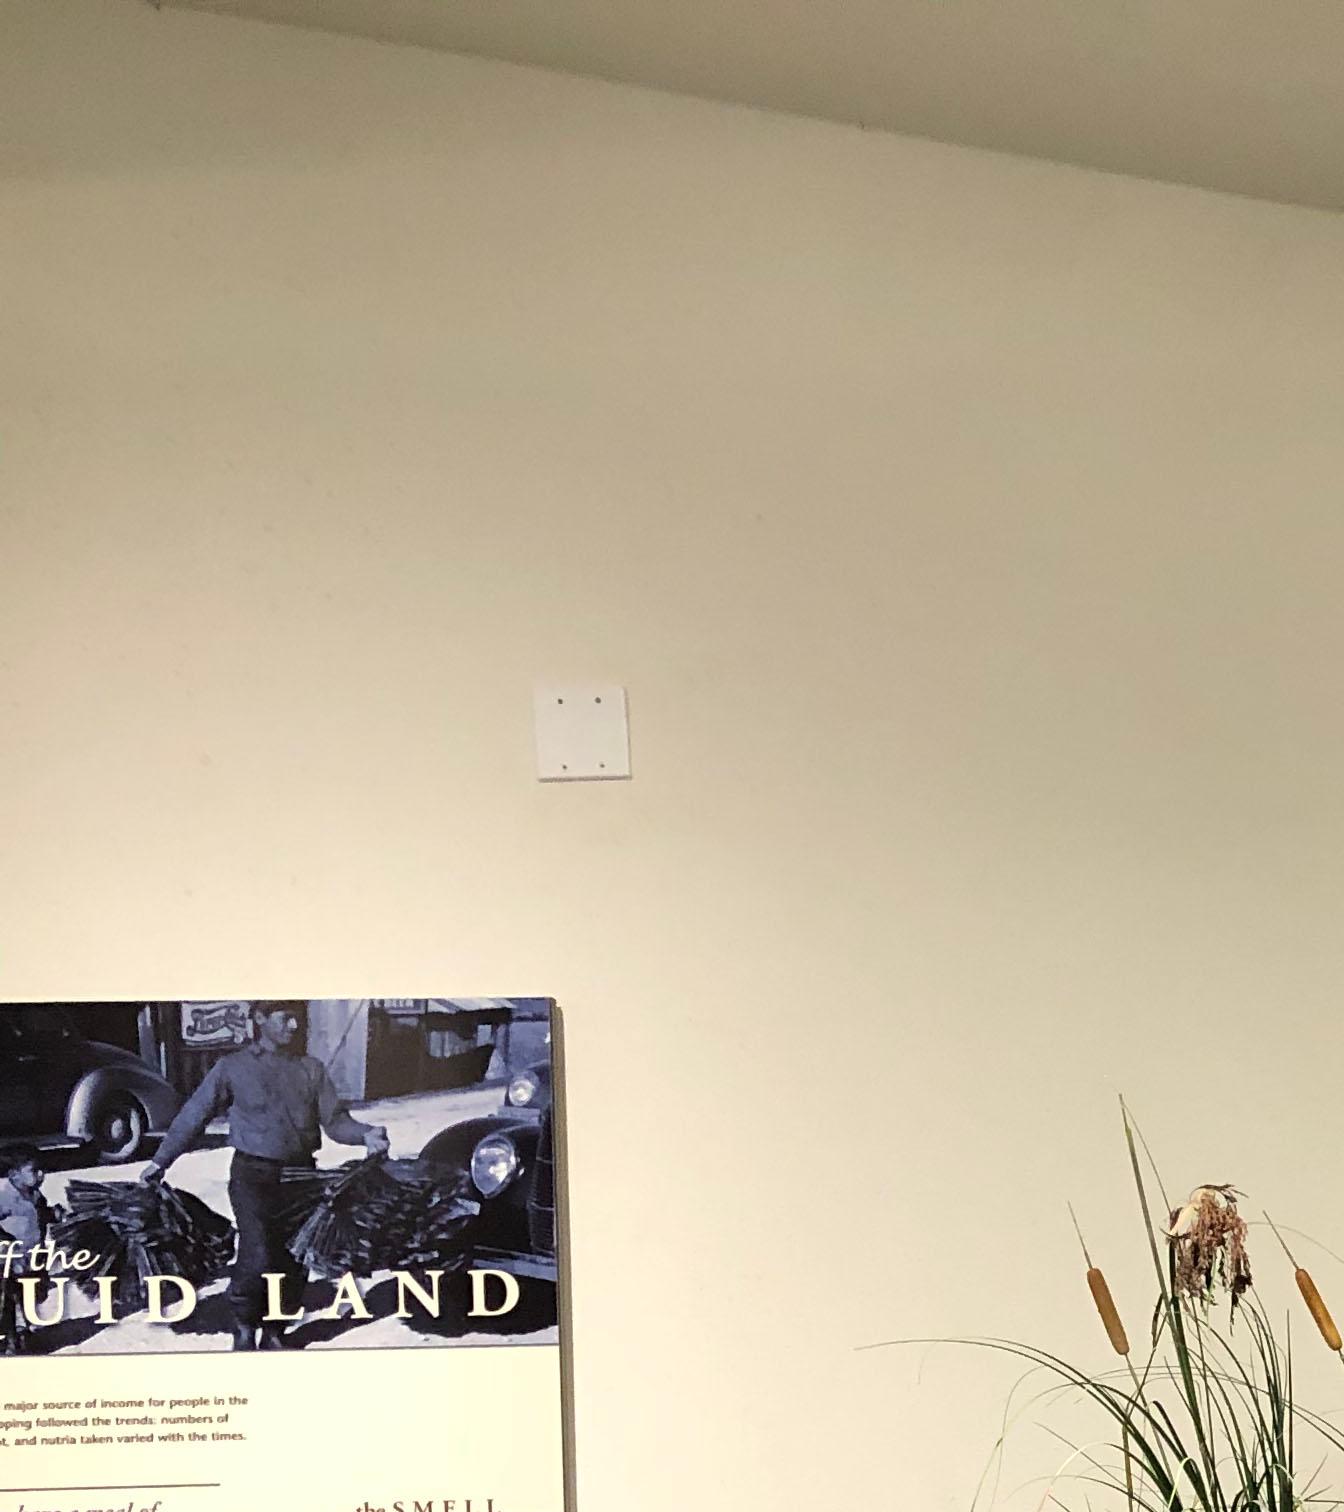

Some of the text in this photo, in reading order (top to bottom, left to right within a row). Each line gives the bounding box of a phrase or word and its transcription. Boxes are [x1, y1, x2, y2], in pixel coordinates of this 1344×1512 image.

[30, 1240, 100, 1272] the
[19, 1269, 522, 1327] UID LAND
[4, 1396, 248, 1412] major source of income for people in the
[36, 1417, 88, 1427] followed
[92, 1417, 111, 1426] the
[161, 1414, 213, 1425] numbers
[217, 1414, 228, 1424] of
[15, 1436, 36, 1446] and
[41, 1435, 76, 1445] nutria
[81, 1434, 113, 1444] taken
[117, 1433, 153, 1443] varied
[158, 1432, 184, 1442] with
[188, 1432, 207, 1442] the
[212, 1431, 246, 1441] times.
